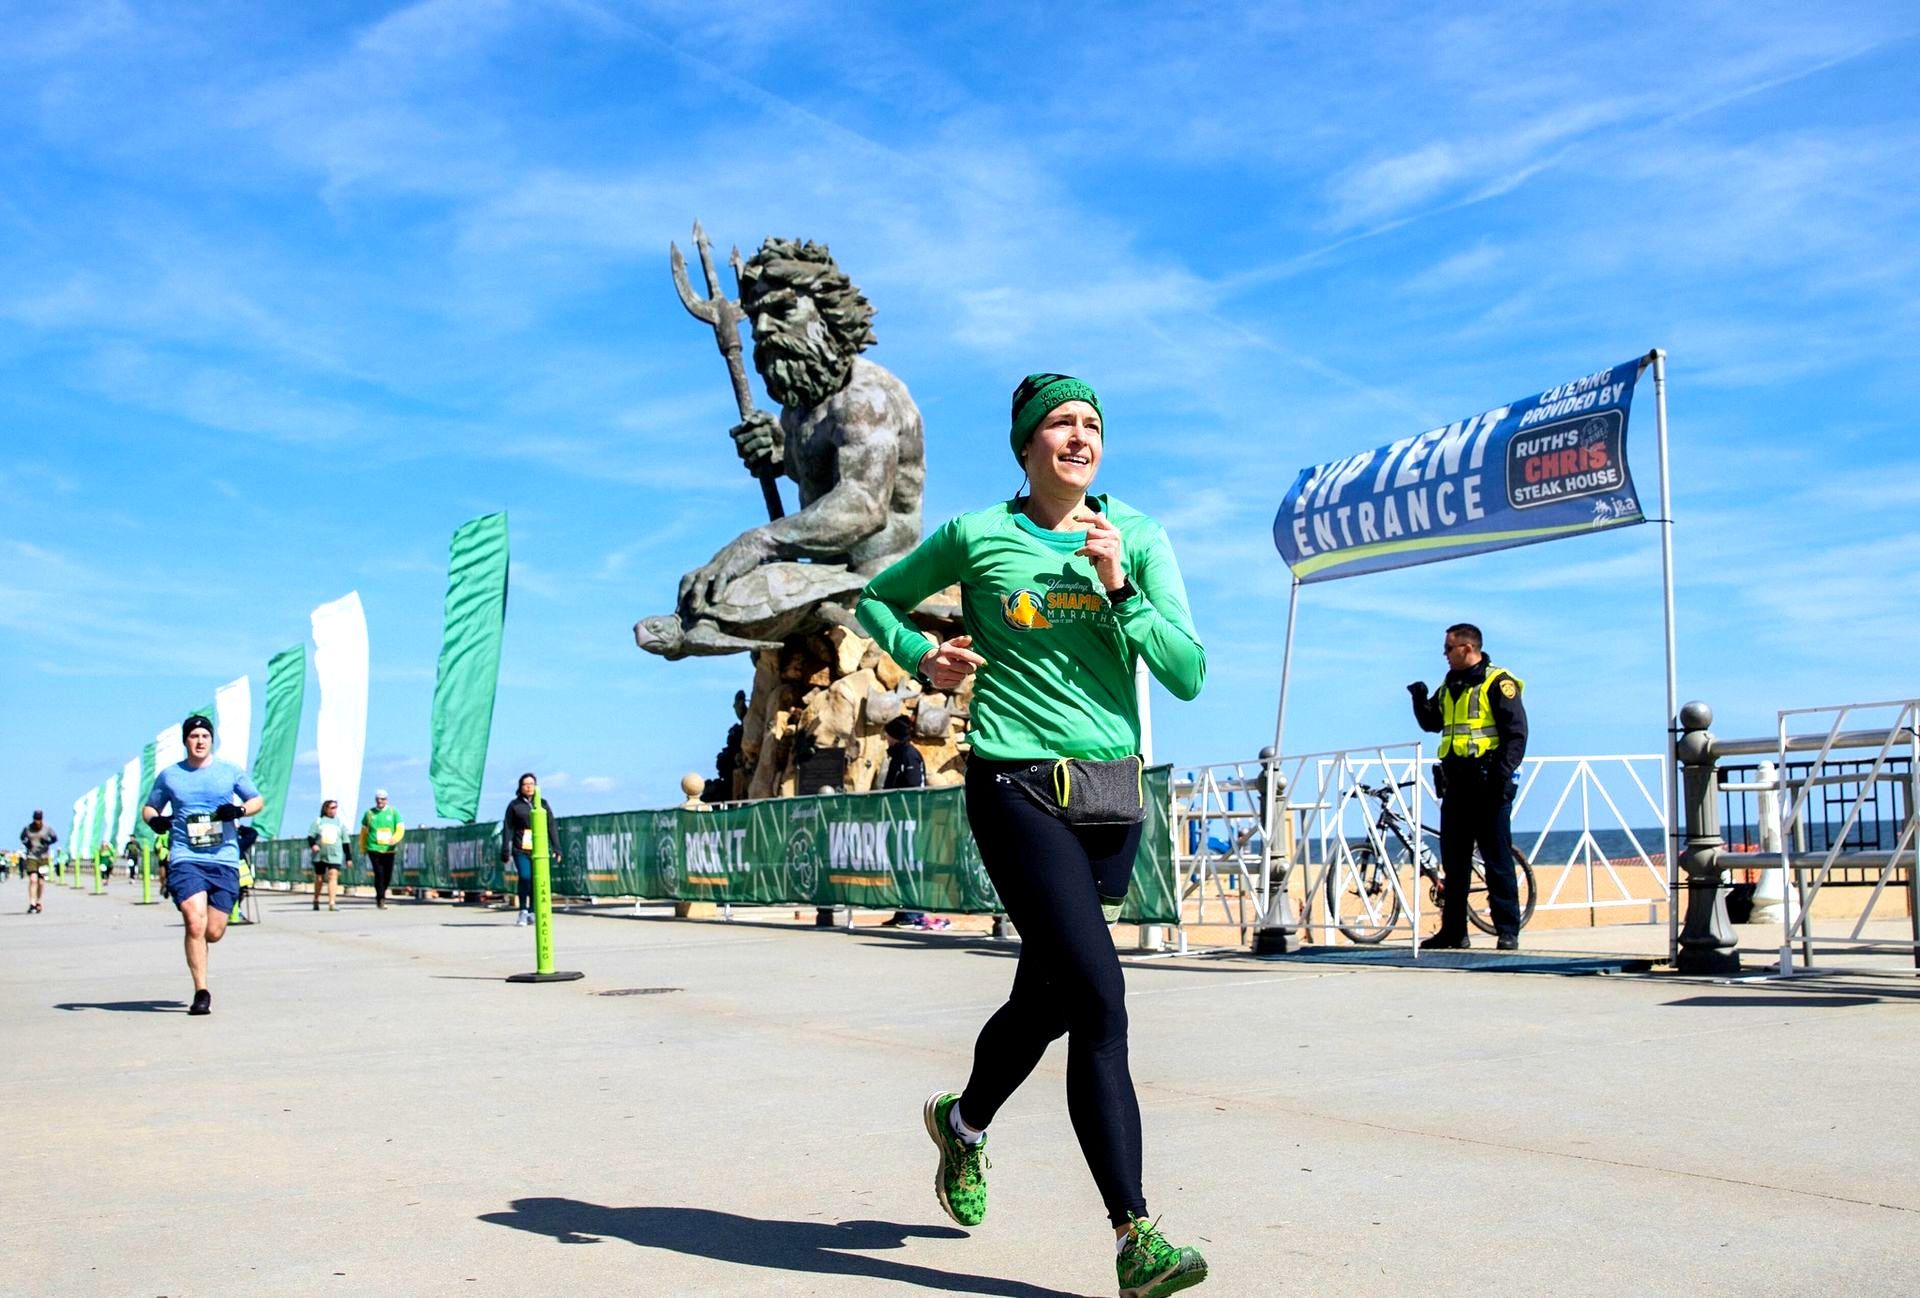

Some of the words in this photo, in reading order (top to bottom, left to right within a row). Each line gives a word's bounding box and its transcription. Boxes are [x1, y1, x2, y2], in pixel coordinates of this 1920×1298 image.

[1519, 390, 1597, 427] PROVIDED
[1598, 381, 1626, 406] BY
[1540, 367, 1613, 405] CATERING
[1294, 449, 1376, 514] VIP
[1373, 405, 1511, 493] TENT
[1516, 429, 1579, 458] RUTH'S
[1525, 442, 1608, 483] CHRIS
[1514, 480, 1562, 502] STEAK
[1565, 468, 1618, 492] HOUSE
[1292, 474, 1485, 557] ENTRANCE
[1047, 609, 1116, 625] MARATHO
[586, 833, 618, 871] BRING
[619, 832, 636, 870] IT.
[685, 831, 724, 873] ROCK
[725, 829, 751, 873] IT.
[829, 820, 892, 871] WORK
[896, 819, 924, 872] IT.
